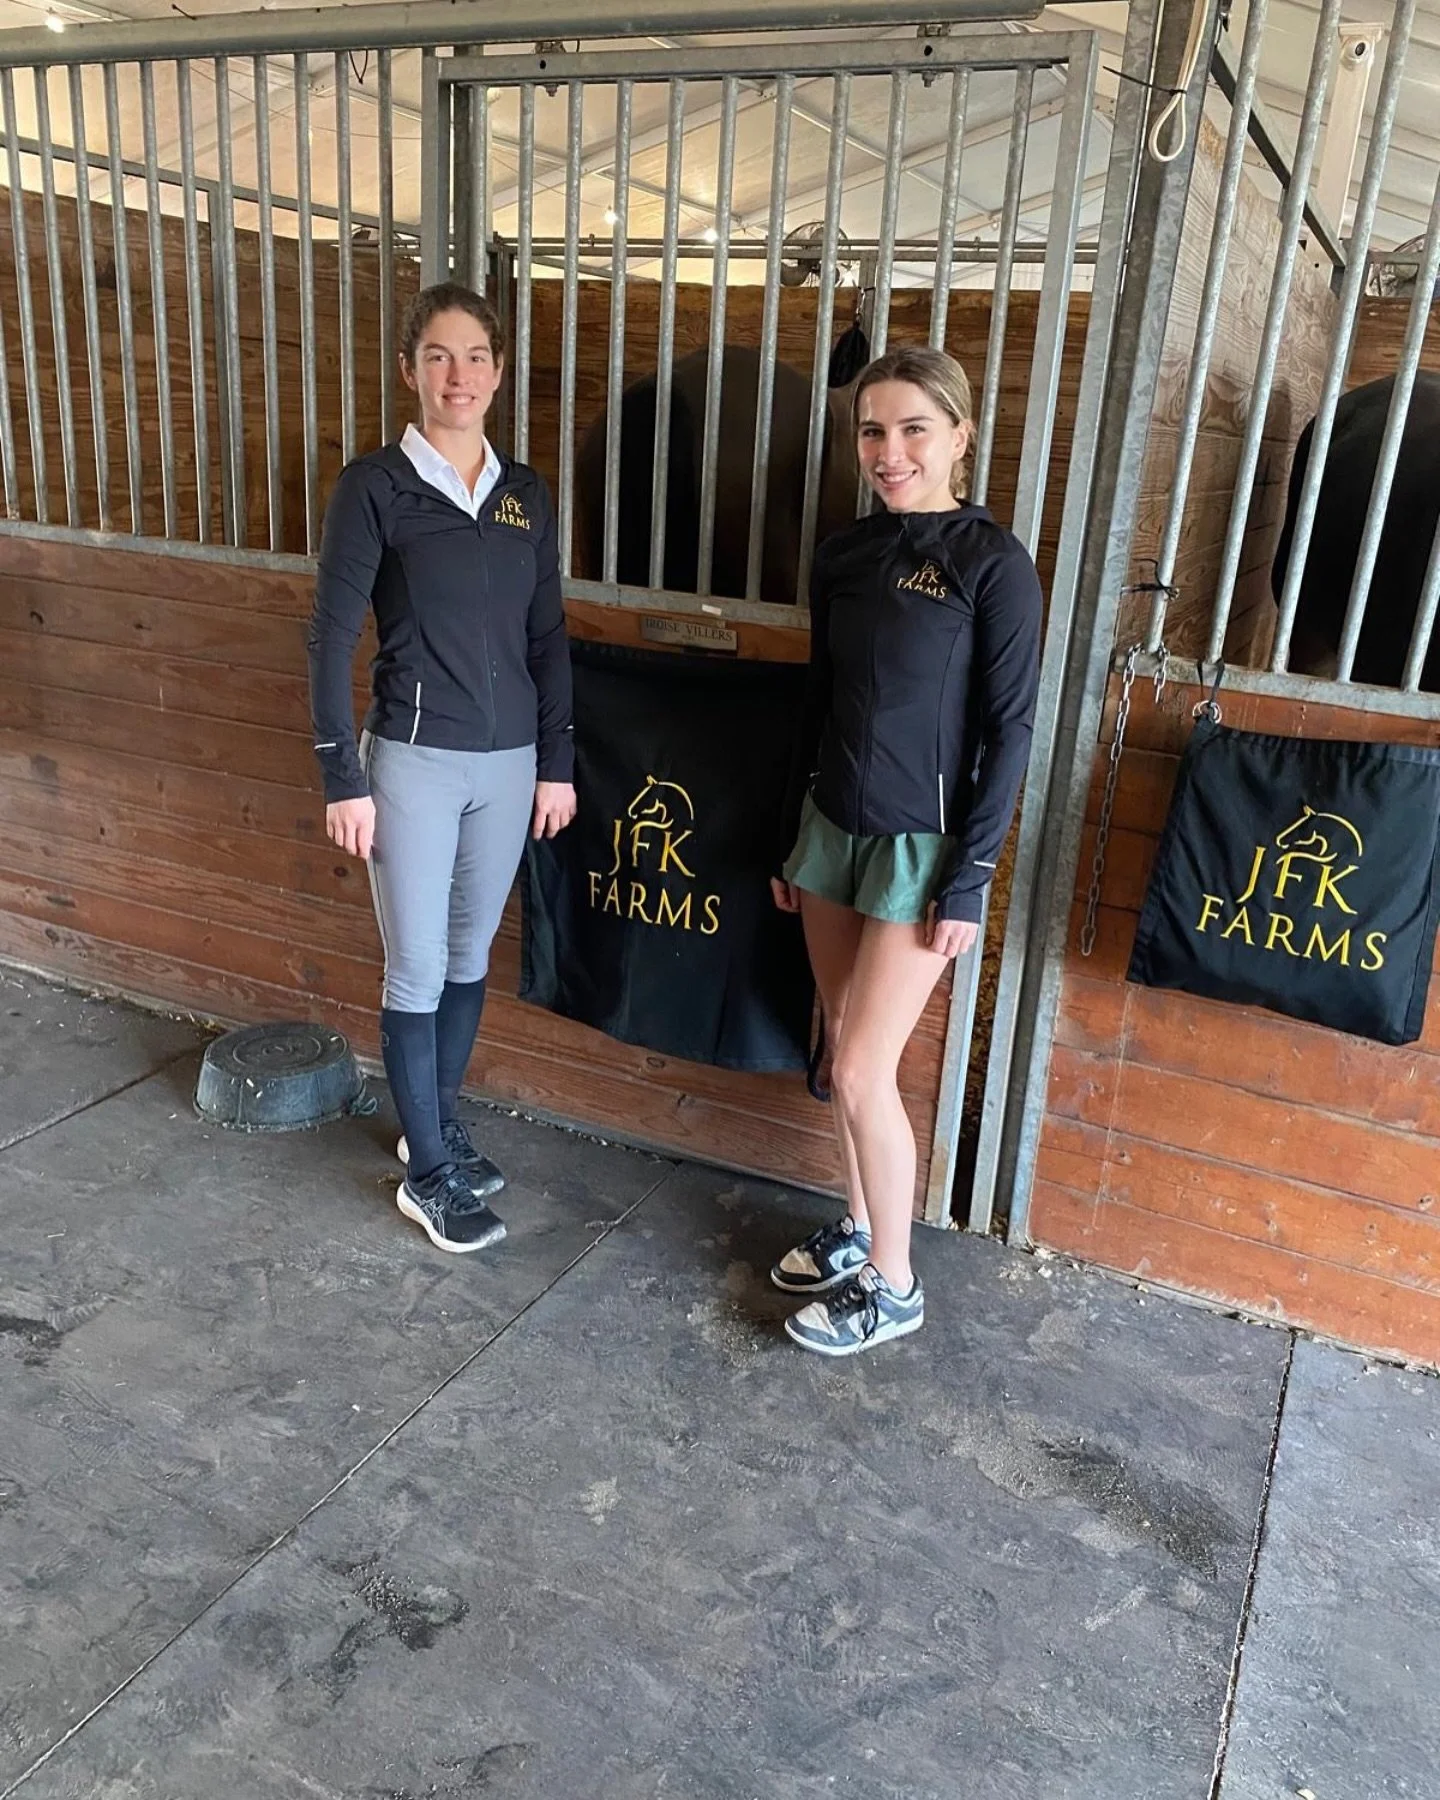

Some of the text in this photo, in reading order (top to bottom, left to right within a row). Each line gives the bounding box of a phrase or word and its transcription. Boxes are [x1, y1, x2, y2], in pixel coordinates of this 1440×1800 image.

[501, 499, 524, 515] JFK
[495, 511, 530, 530] FARMS
[897, 577, 947, 599] FARMS
[911, 571, 941, 583] JFK
[686, 625, 733, 641] VILLERS
[608, 819, 696, 878] JFK
[1236, 846, 1360, 915] JFK
[588, 870, 721, 935] FARMS
[1195, 893, 1387, 971] FARMS
